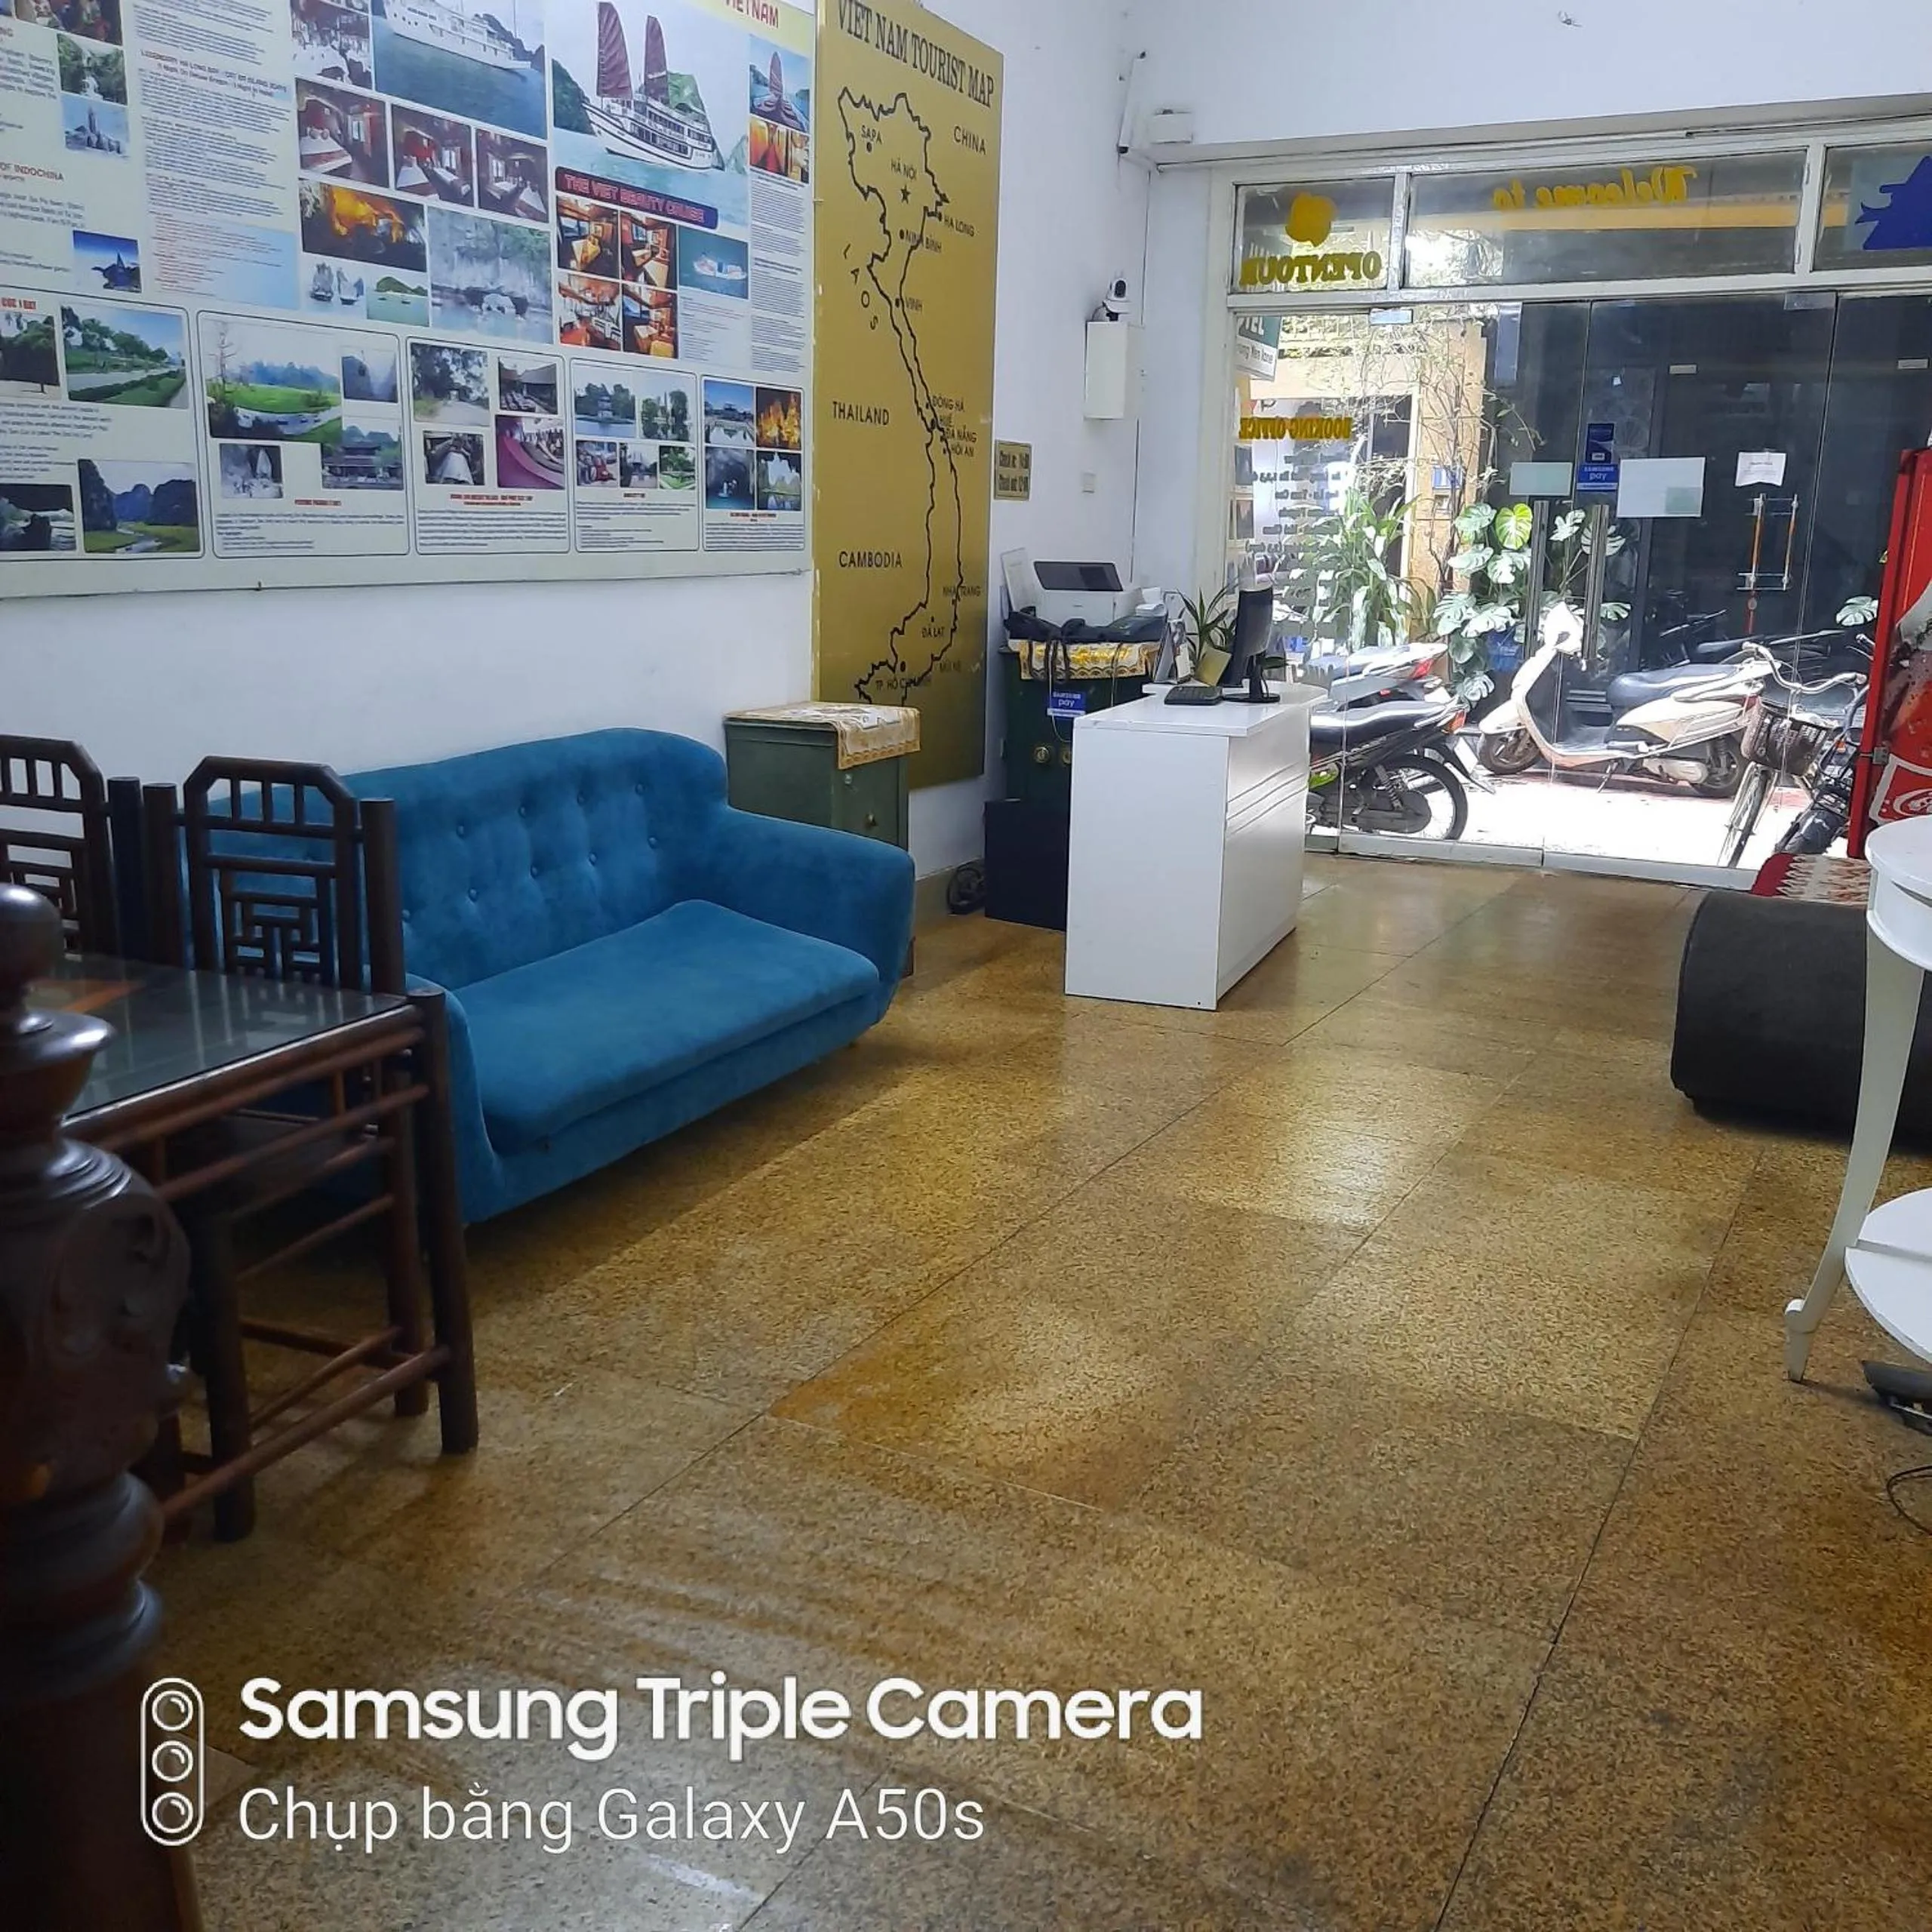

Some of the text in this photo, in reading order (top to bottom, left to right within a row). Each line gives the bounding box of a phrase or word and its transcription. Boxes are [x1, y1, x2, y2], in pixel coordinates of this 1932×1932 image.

[838, 0, 994, 108] VIET NAM TOURIST MAP
[954, 125, 986, 155] CHINA
[14, 165, 64, 181] INDOCHINA
[565, 173, 589, 194] THE
[620, 187, 663, 212] BEAUTY
[832, 401, 890, 426] THAILAND
[1589, 472, 1607, 481] pay
[838, 551, 903, 568] CAMBODIA
[1058, 699, 1075, 708] pay
